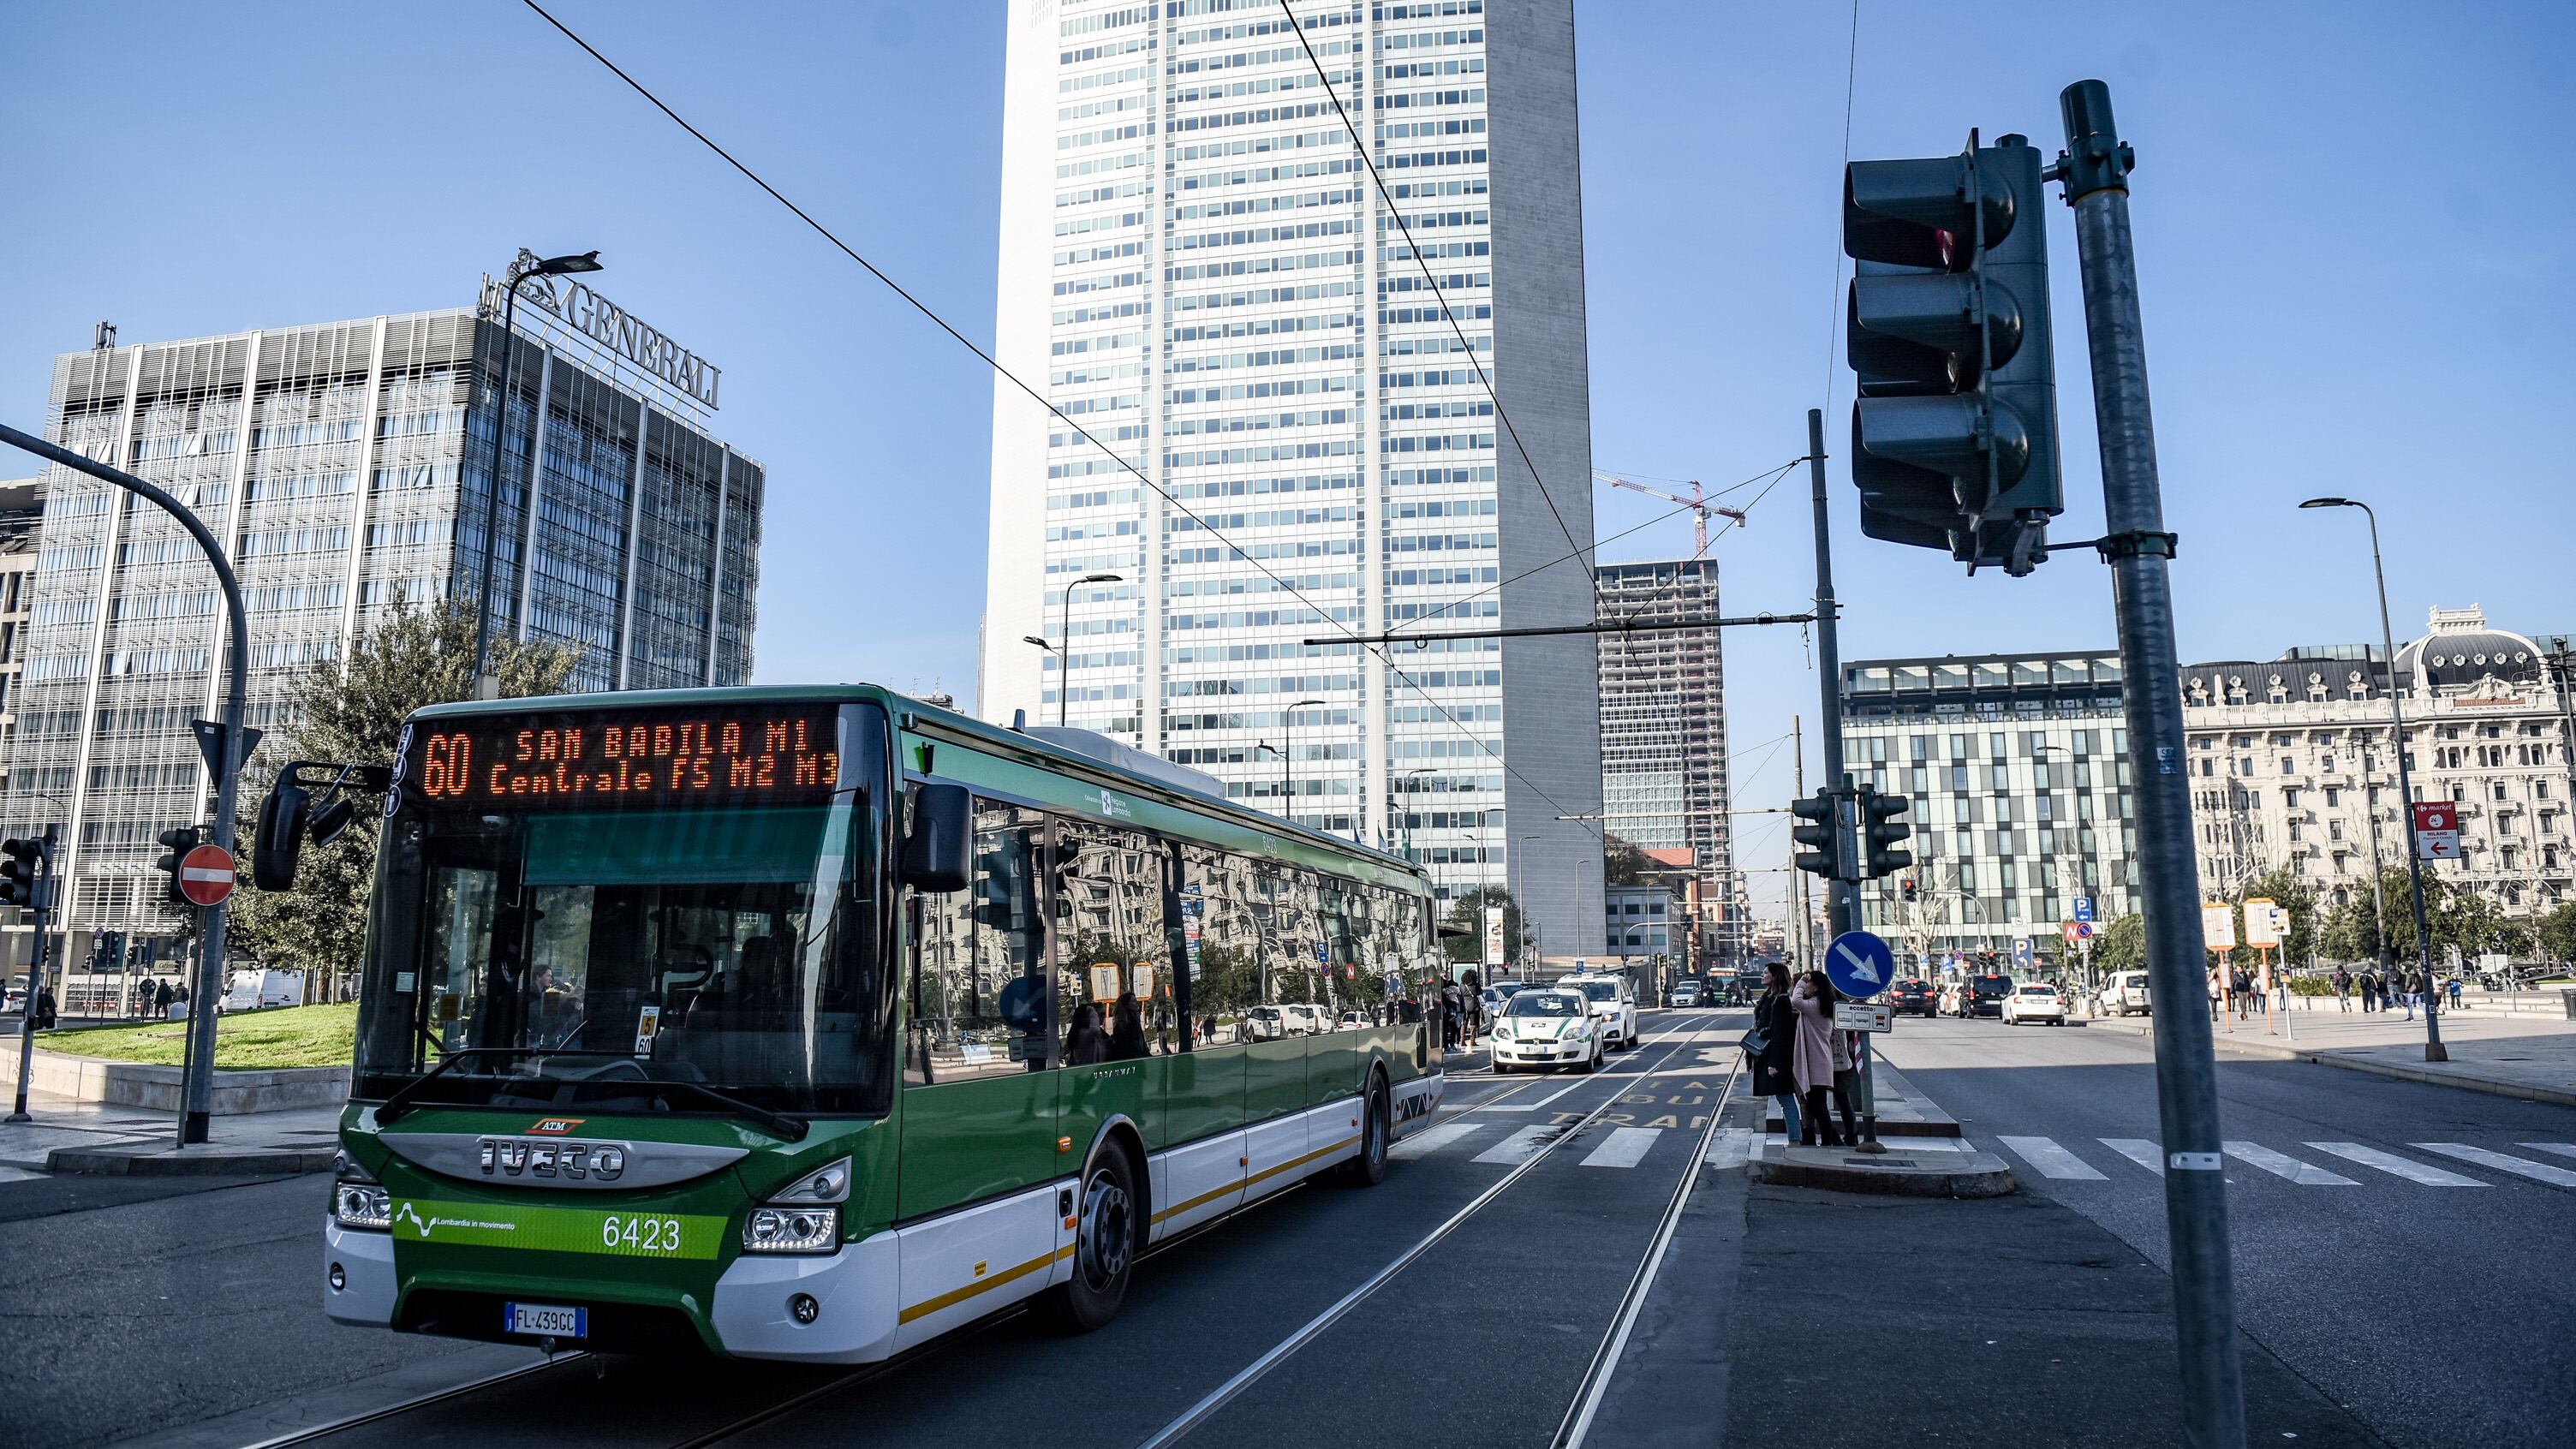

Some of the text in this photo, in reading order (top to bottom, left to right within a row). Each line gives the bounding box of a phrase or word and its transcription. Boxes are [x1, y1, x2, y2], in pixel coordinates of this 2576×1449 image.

[568, 283, 721, 410] GENERALI
[516, 720, 807, 760] SAN BABILA M1
[424, 733, 470, 796] 60
[490, 747, 838, 794] Centrale FS M2 M3
[1262, 836, 1278, 854] 6423
[2077, 899, 2087, 912] P
[2015, 940, 2028, 956] P
[644, 1017, 652, 1035] 5
[638, 1038, 651, 1052] 60
[541, 1122, 567, 1131] ATM
[480, 1140, 625, 1181] IVECO
[437, 1218, 470, 1227] Lombardia
[479, 1221, 516, 1231] movimento
[603, 1216, 680, 1250] 6423
